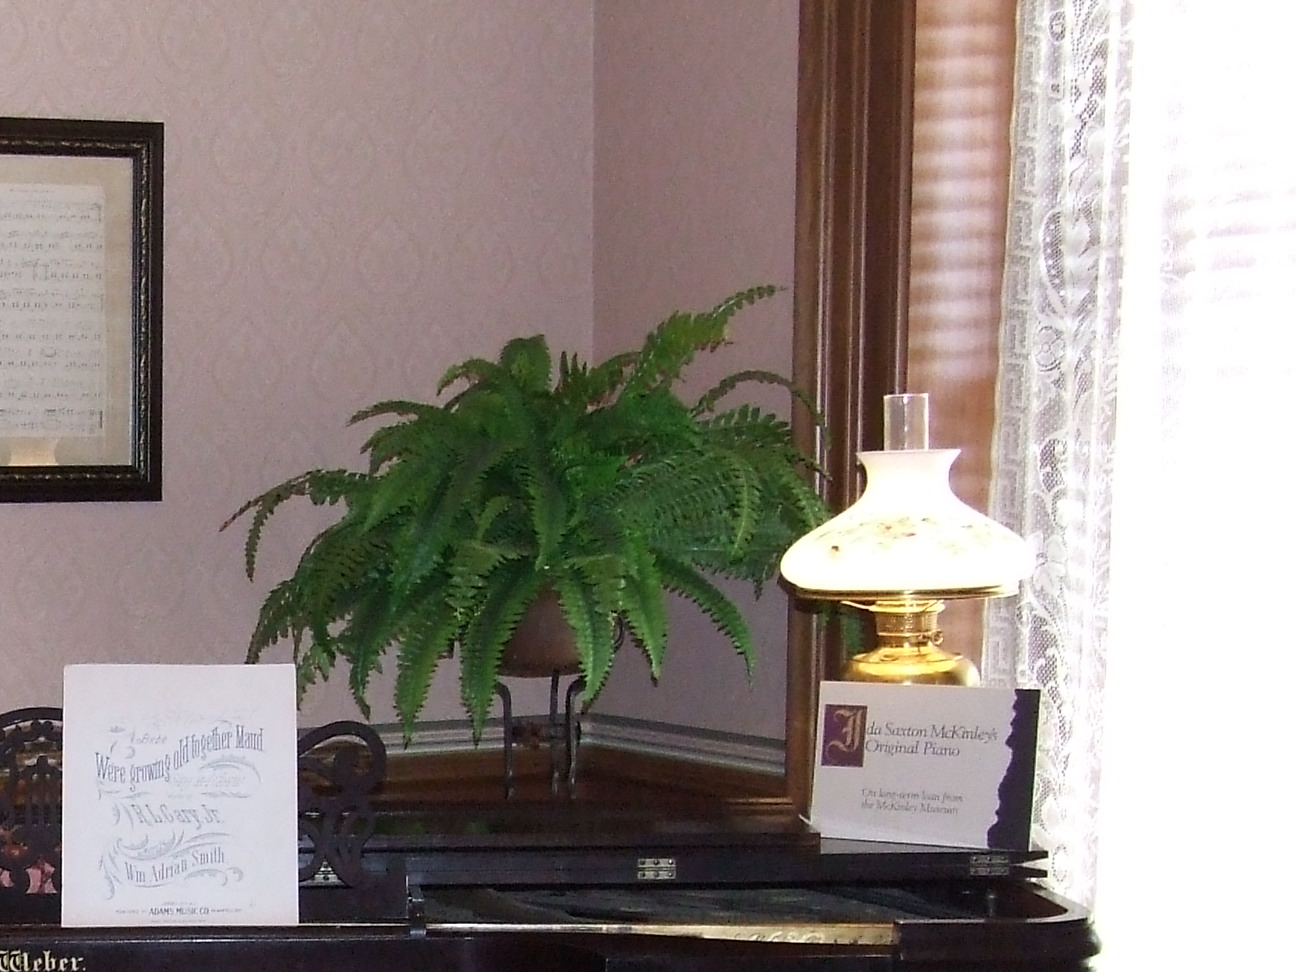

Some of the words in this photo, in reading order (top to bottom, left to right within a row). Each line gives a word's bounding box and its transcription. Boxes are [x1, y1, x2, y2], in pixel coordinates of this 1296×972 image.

[885, 722, 928, 739] Saxton
[865, 738, 920, 757] Original
[923, 740, 961, 756] Piano
[129, 753, 171, 793] growing
[173, 738, 190, 771] old
[191, 726, 233, 762] together
[150, 859, 188, 883] Adrian
[191, 846, 225, 866] Smith
[149, 906, 174, 915] ADAMS
[176, 906, 198, 915] MUSIC
